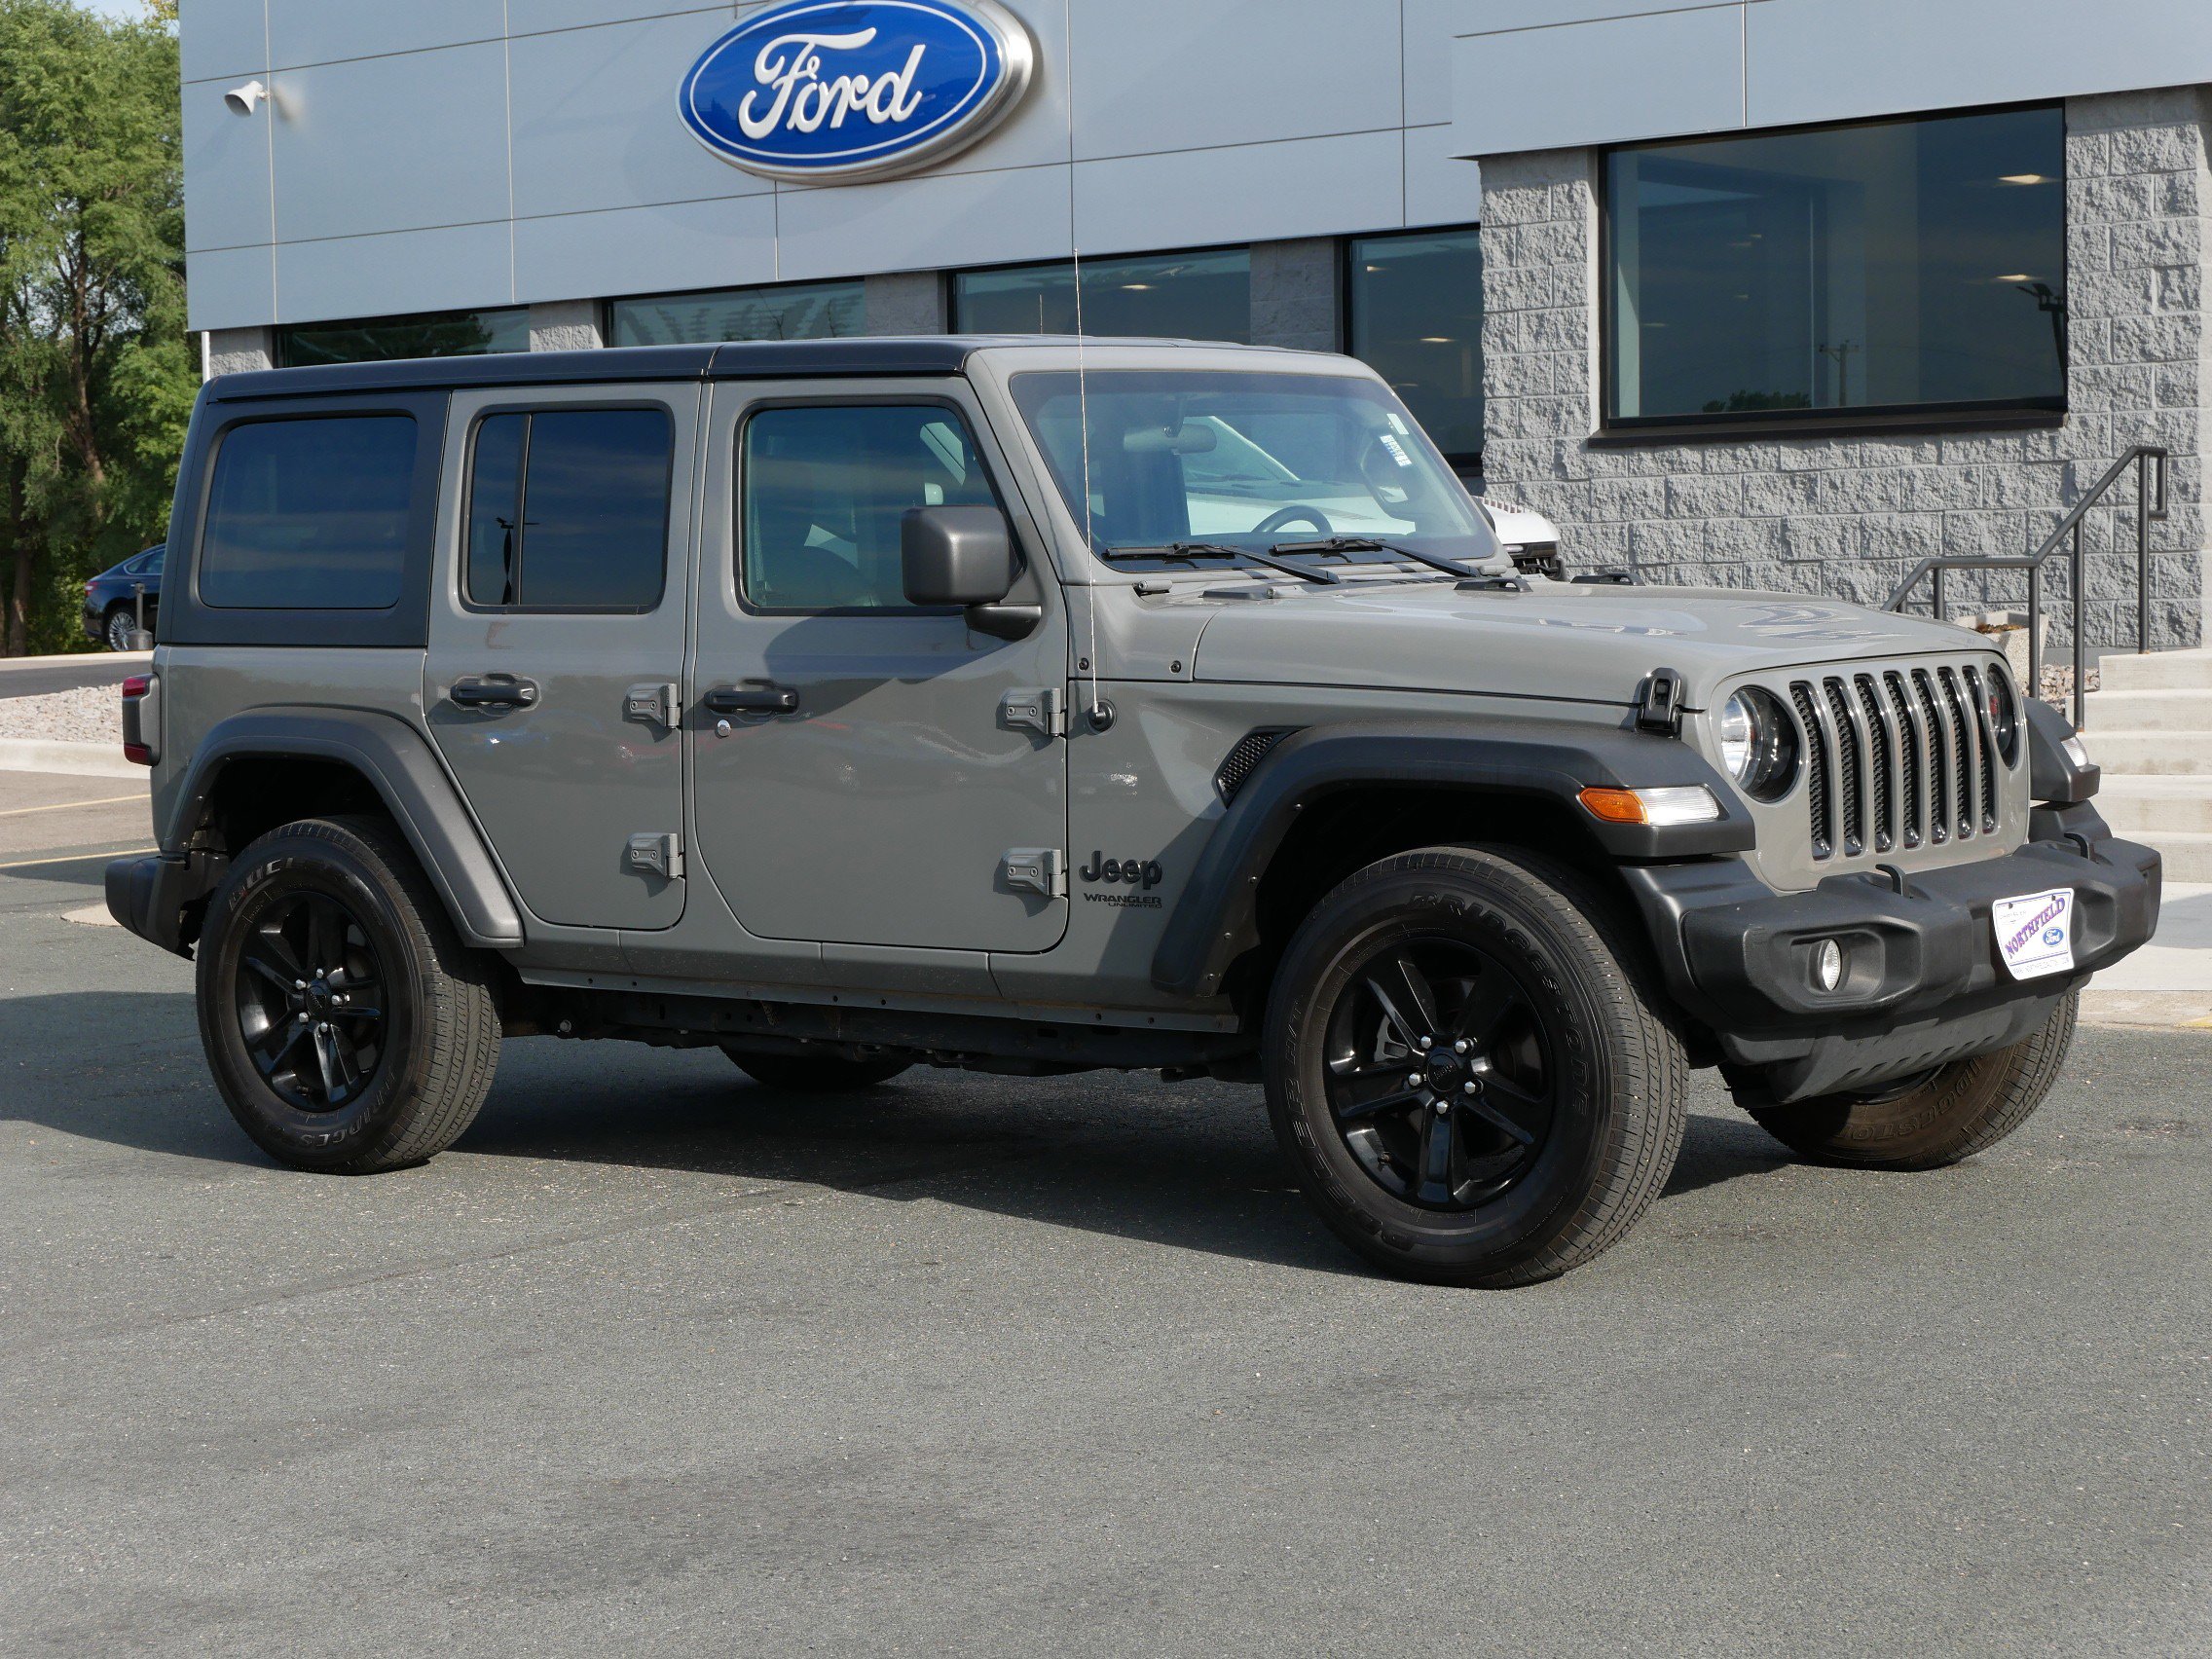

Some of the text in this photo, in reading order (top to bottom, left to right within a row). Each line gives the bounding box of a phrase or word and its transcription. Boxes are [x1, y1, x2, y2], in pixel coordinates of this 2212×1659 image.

[738, 27, 926, 139] Ford
[1079, 850, 1162, 890] Jeep
[1084, 893, 1161, 903] WRANGLER
[2005, 898, 2065, 959] NORTHFIELD
[2046, 929, 2061, 944] Ford
[1405, 892, 1590, 1117] BRIDGESTONE
